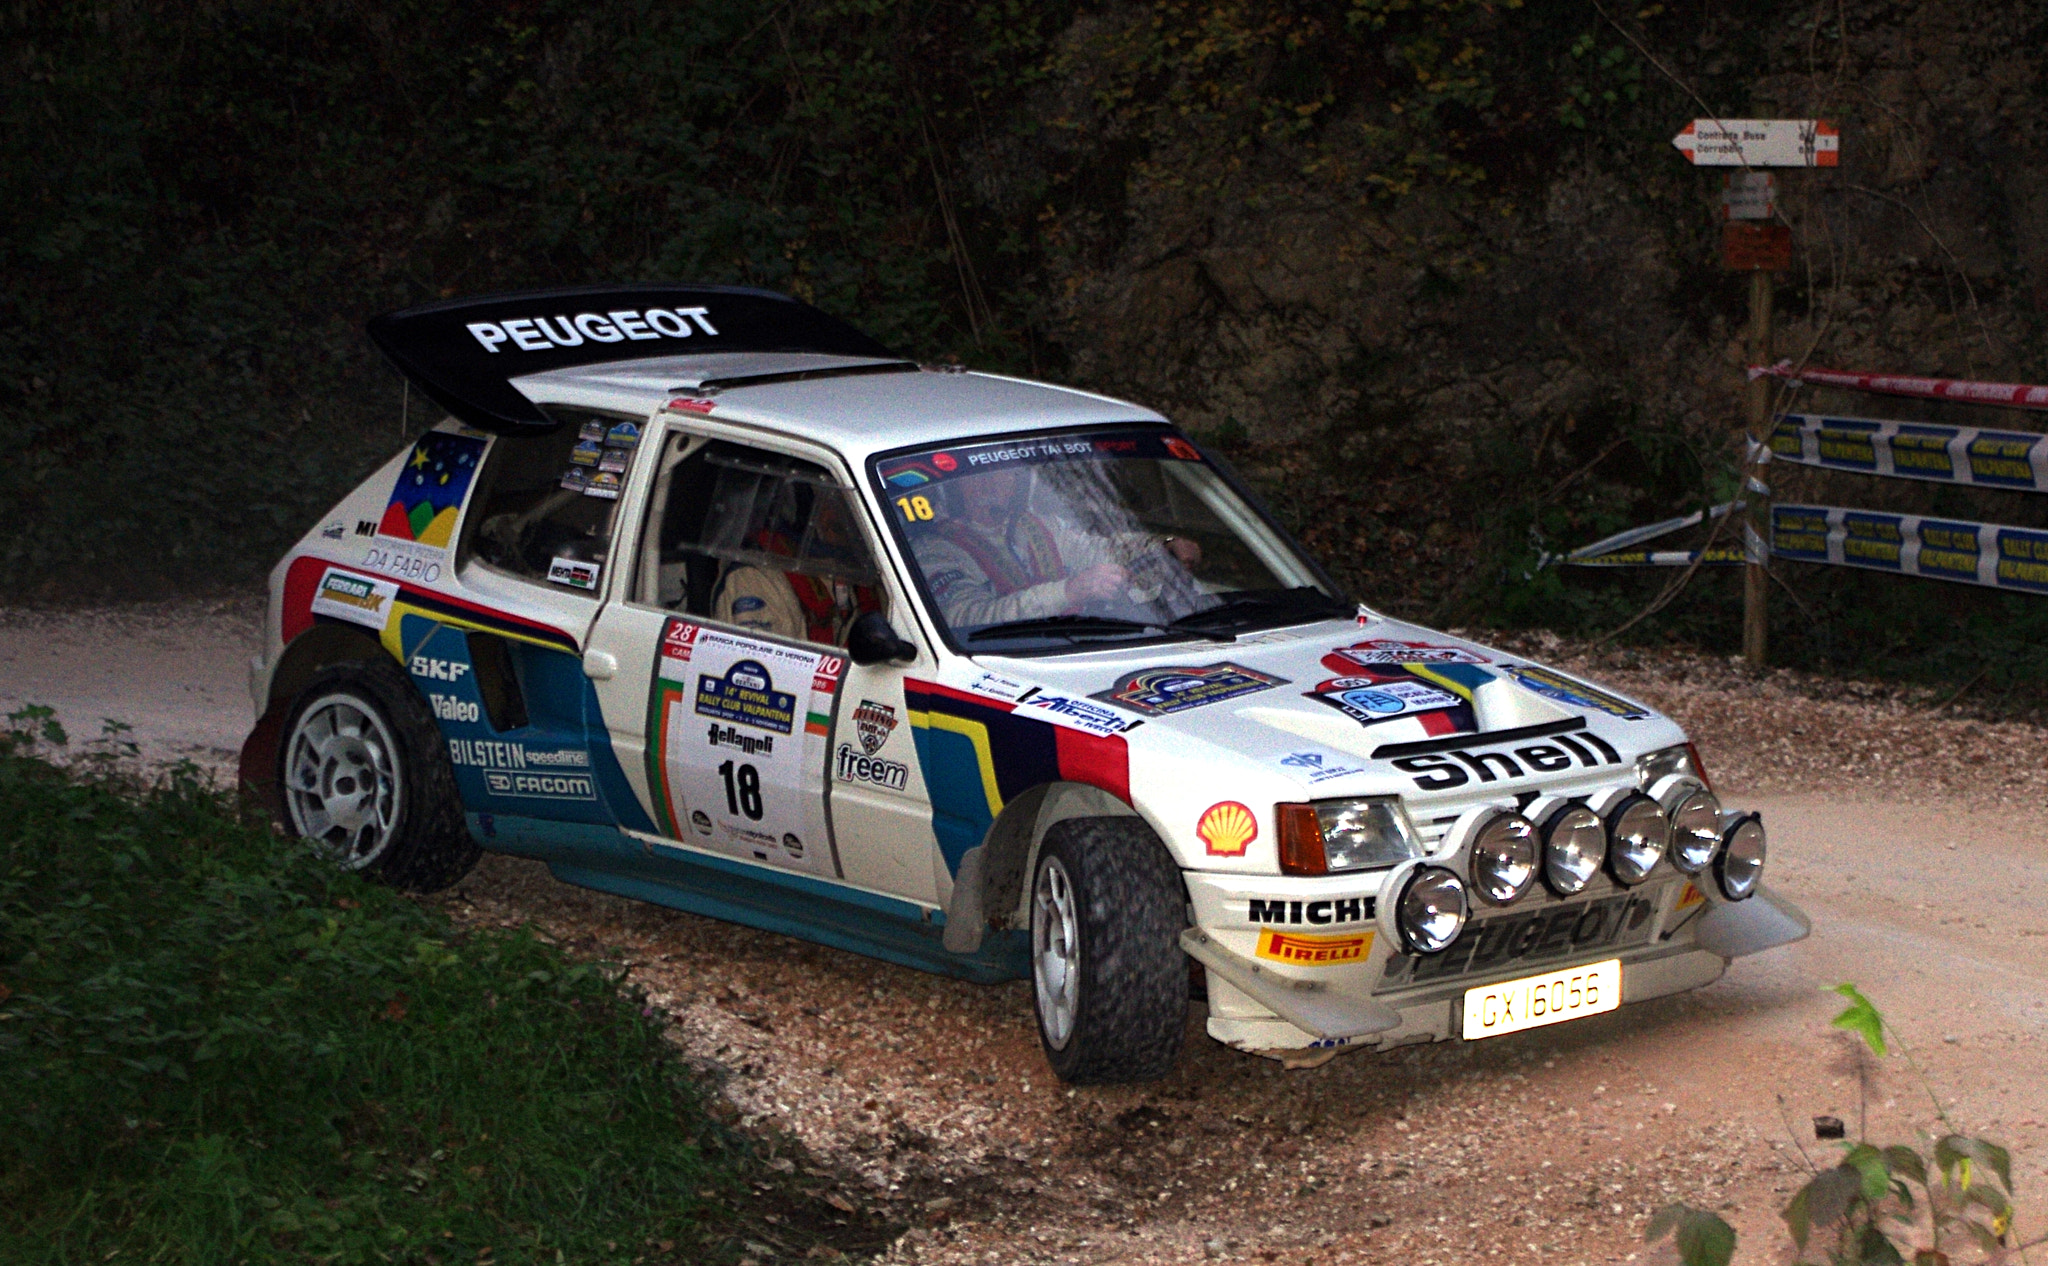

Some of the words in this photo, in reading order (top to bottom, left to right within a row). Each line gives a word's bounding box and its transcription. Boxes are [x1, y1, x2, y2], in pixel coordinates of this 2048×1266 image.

[466, 307, 719, 353] PEUGEOT
[967, 446, 1036, 467] PEUGEOT
[897, 496, 935, 523] 18
[362, 549, 387, 570] DA
[389, 555, 441, 583] FABIO
[735, 640, 773, 655] POPOLARE
[775, 649, 784, 657] DI
[785, 651, 815, 664] VERONA
[411, 656, 469, 682] SKF
[429, 694, 479, 723] Valeo
[721, 698, 741, 711] CLUB
[742, 703, 791, 723] VALPANTENA
[738, 689, 769, 705] REVIVAL
[1070, 700, 1117, 717] OFFICINA
[1083, 722, 1114, 734] IVECO
[450, 739, 526, 768] BILSTEIN
[526, 750, 586, 766] speedline
[839, 745, 907, 788] freem
[1391, 731, 1622, 791] Shell
[515, 777, 591, 795] FACOM
[718, 760, 763, 821] 18
[1269, 933, 1364, 962] PIRELLI
